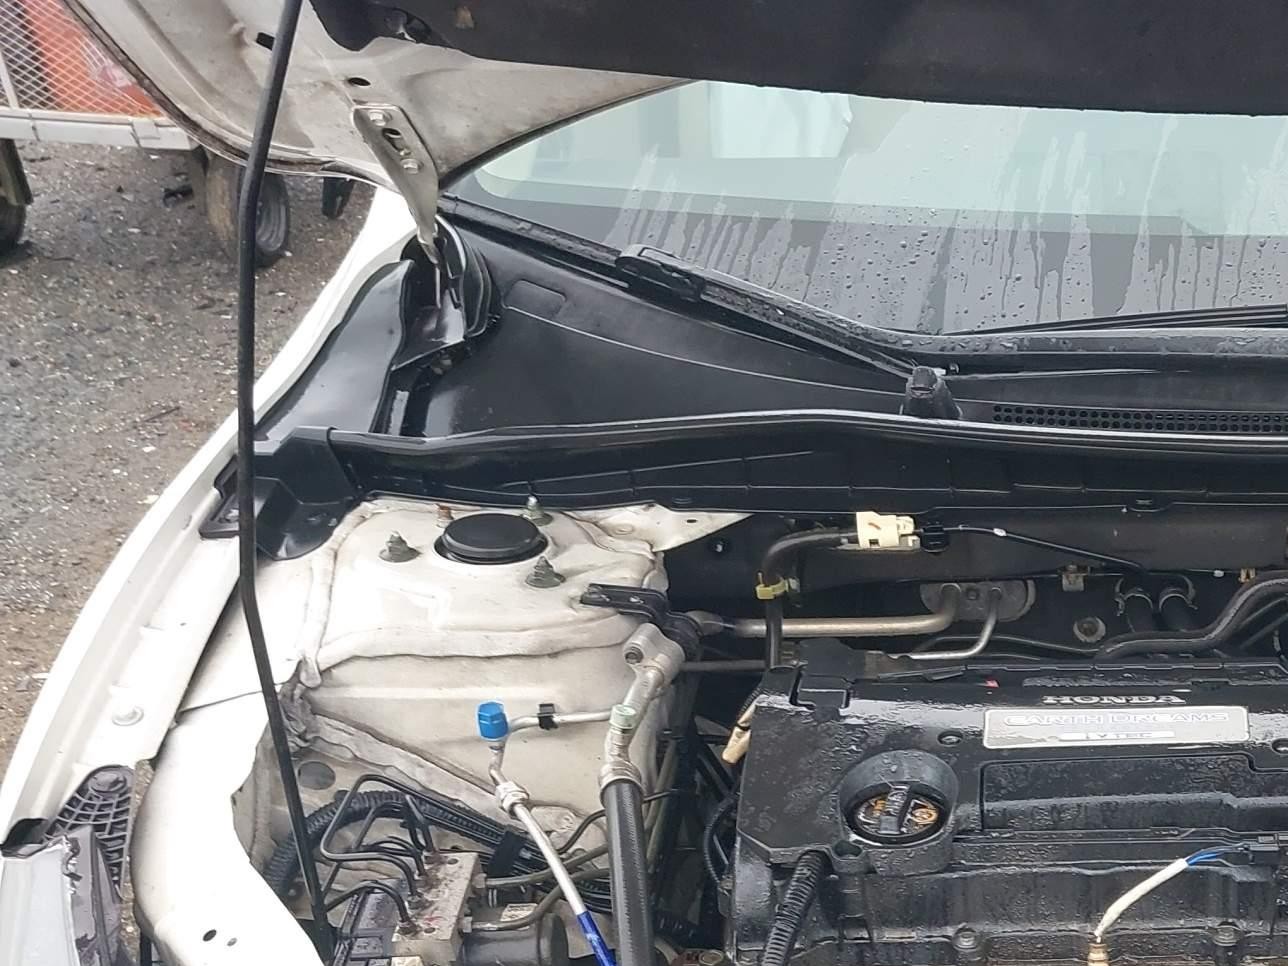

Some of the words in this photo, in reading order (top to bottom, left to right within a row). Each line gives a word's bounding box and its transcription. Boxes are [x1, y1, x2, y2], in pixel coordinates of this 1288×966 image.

[1041, 695, 1186, 705] HONDA
[1003, 715, 1104, 726] EARTH
[1109, 712, 1229, 724] DREAMS
